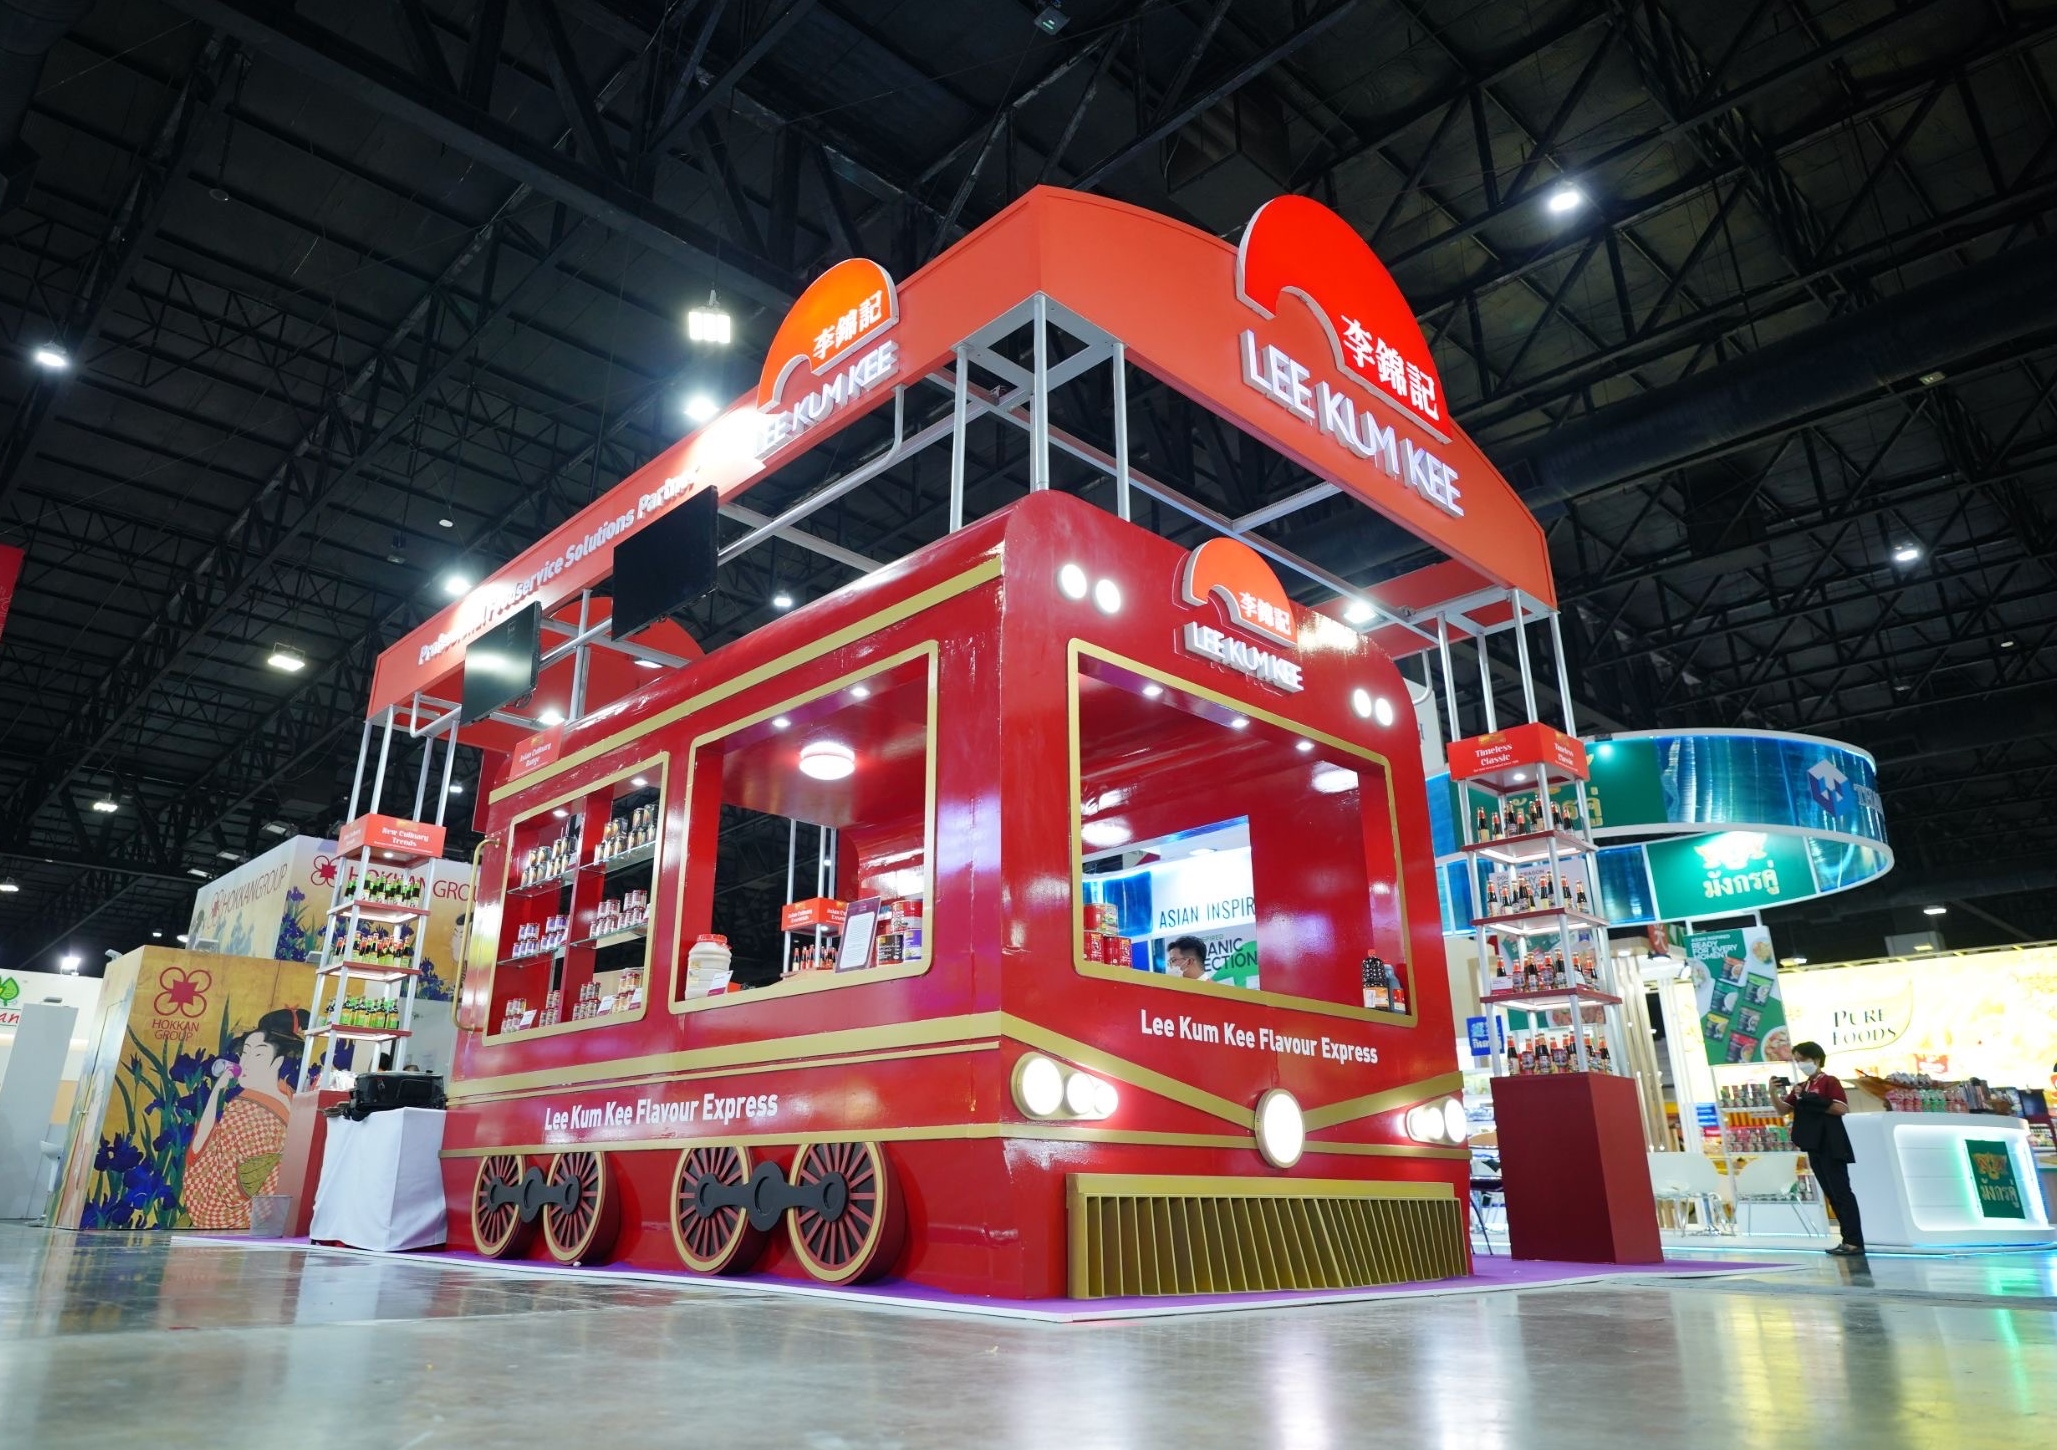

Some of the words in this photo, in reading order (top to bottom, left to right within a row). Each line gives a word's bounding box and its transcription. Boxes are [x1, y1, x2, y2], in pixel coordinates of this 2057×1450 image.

[812, 289, 883, 360] 李錦記
[792, 372, 850, 432] KUM
[848, 339, 899, 397] KEE
[1340, 314, 1440, 421] 李錦記
[1240, 329, 1315, 422] LEE
[1315, 380, 1400, 477] KUM
[1400, 437, 1464, 518] KEE
[564, 508, 635, 569] Solutions
[1239, 591, 1292, 636] 李錦記
[1184, 621, 1226, 664] LEE
[1222, 636, 1270, 679] KUM
[1265, 654, 1304, 694] KEE
[1475, 743, 1513, 758] Timeless
[1480, 753, 1511, 766] Classic
[382, 826, 398, 836] New
[398, 830, 430, 843] Culinary
[391, 837, 417, 848] Trends
[1702, 859, 1780, 898] มังกรคู่
[1159, 905, 1199, 929] ASIAN
[1691, 940, 1718, 950] READY
[152, 1018, 200, 1032] HOKKAN
[154, 1029, 194, 1042] GROUP
[1140, 1008, 1175, 1038] Lee
[1179, 1015, 1219, 1044] Kum
[1223, 1022, 1255, 1049] Kee
[1259, 1027, 1318, 1057] Flavour
[1320, 1036, 1379, 1065] Express
[545, 1107, 569, 1131] Lee
[570, 1105, 602, 1130] Kum
[604, 1101, 633, 1128] Kee
[635, 1098, 700, 1126] Flavour
[702, 1093, 778, 1126] Express
